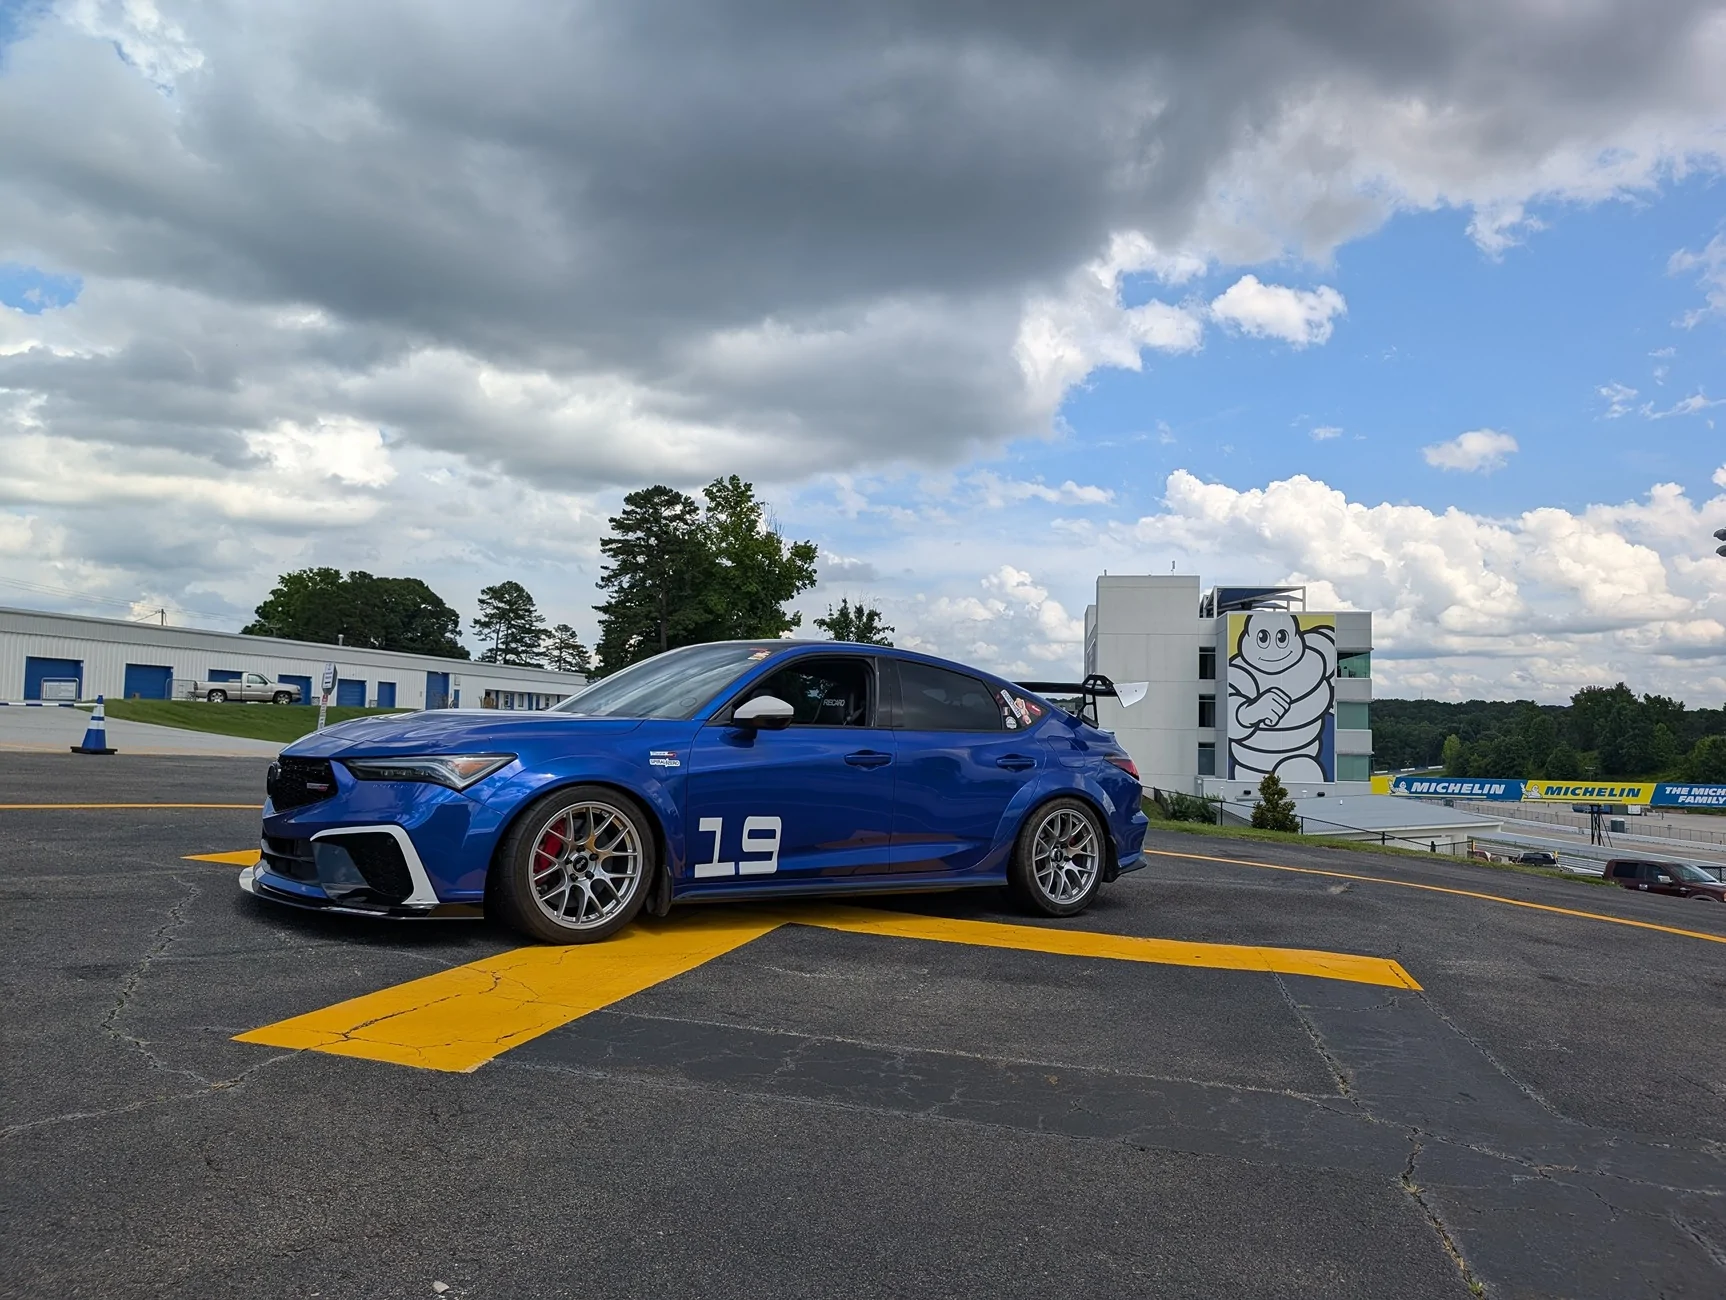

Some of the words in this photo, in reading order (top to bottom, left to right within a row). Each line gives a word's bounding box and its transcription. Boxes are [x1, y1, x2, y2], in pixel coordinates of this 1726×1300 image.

[1411, 782, 1505, 794] MICHELIN
[1544, 786, 1642, 798] MICHELIN
[1678, 795, 1726, 804] FAMILY
[695, 816, 782, 878] 19
